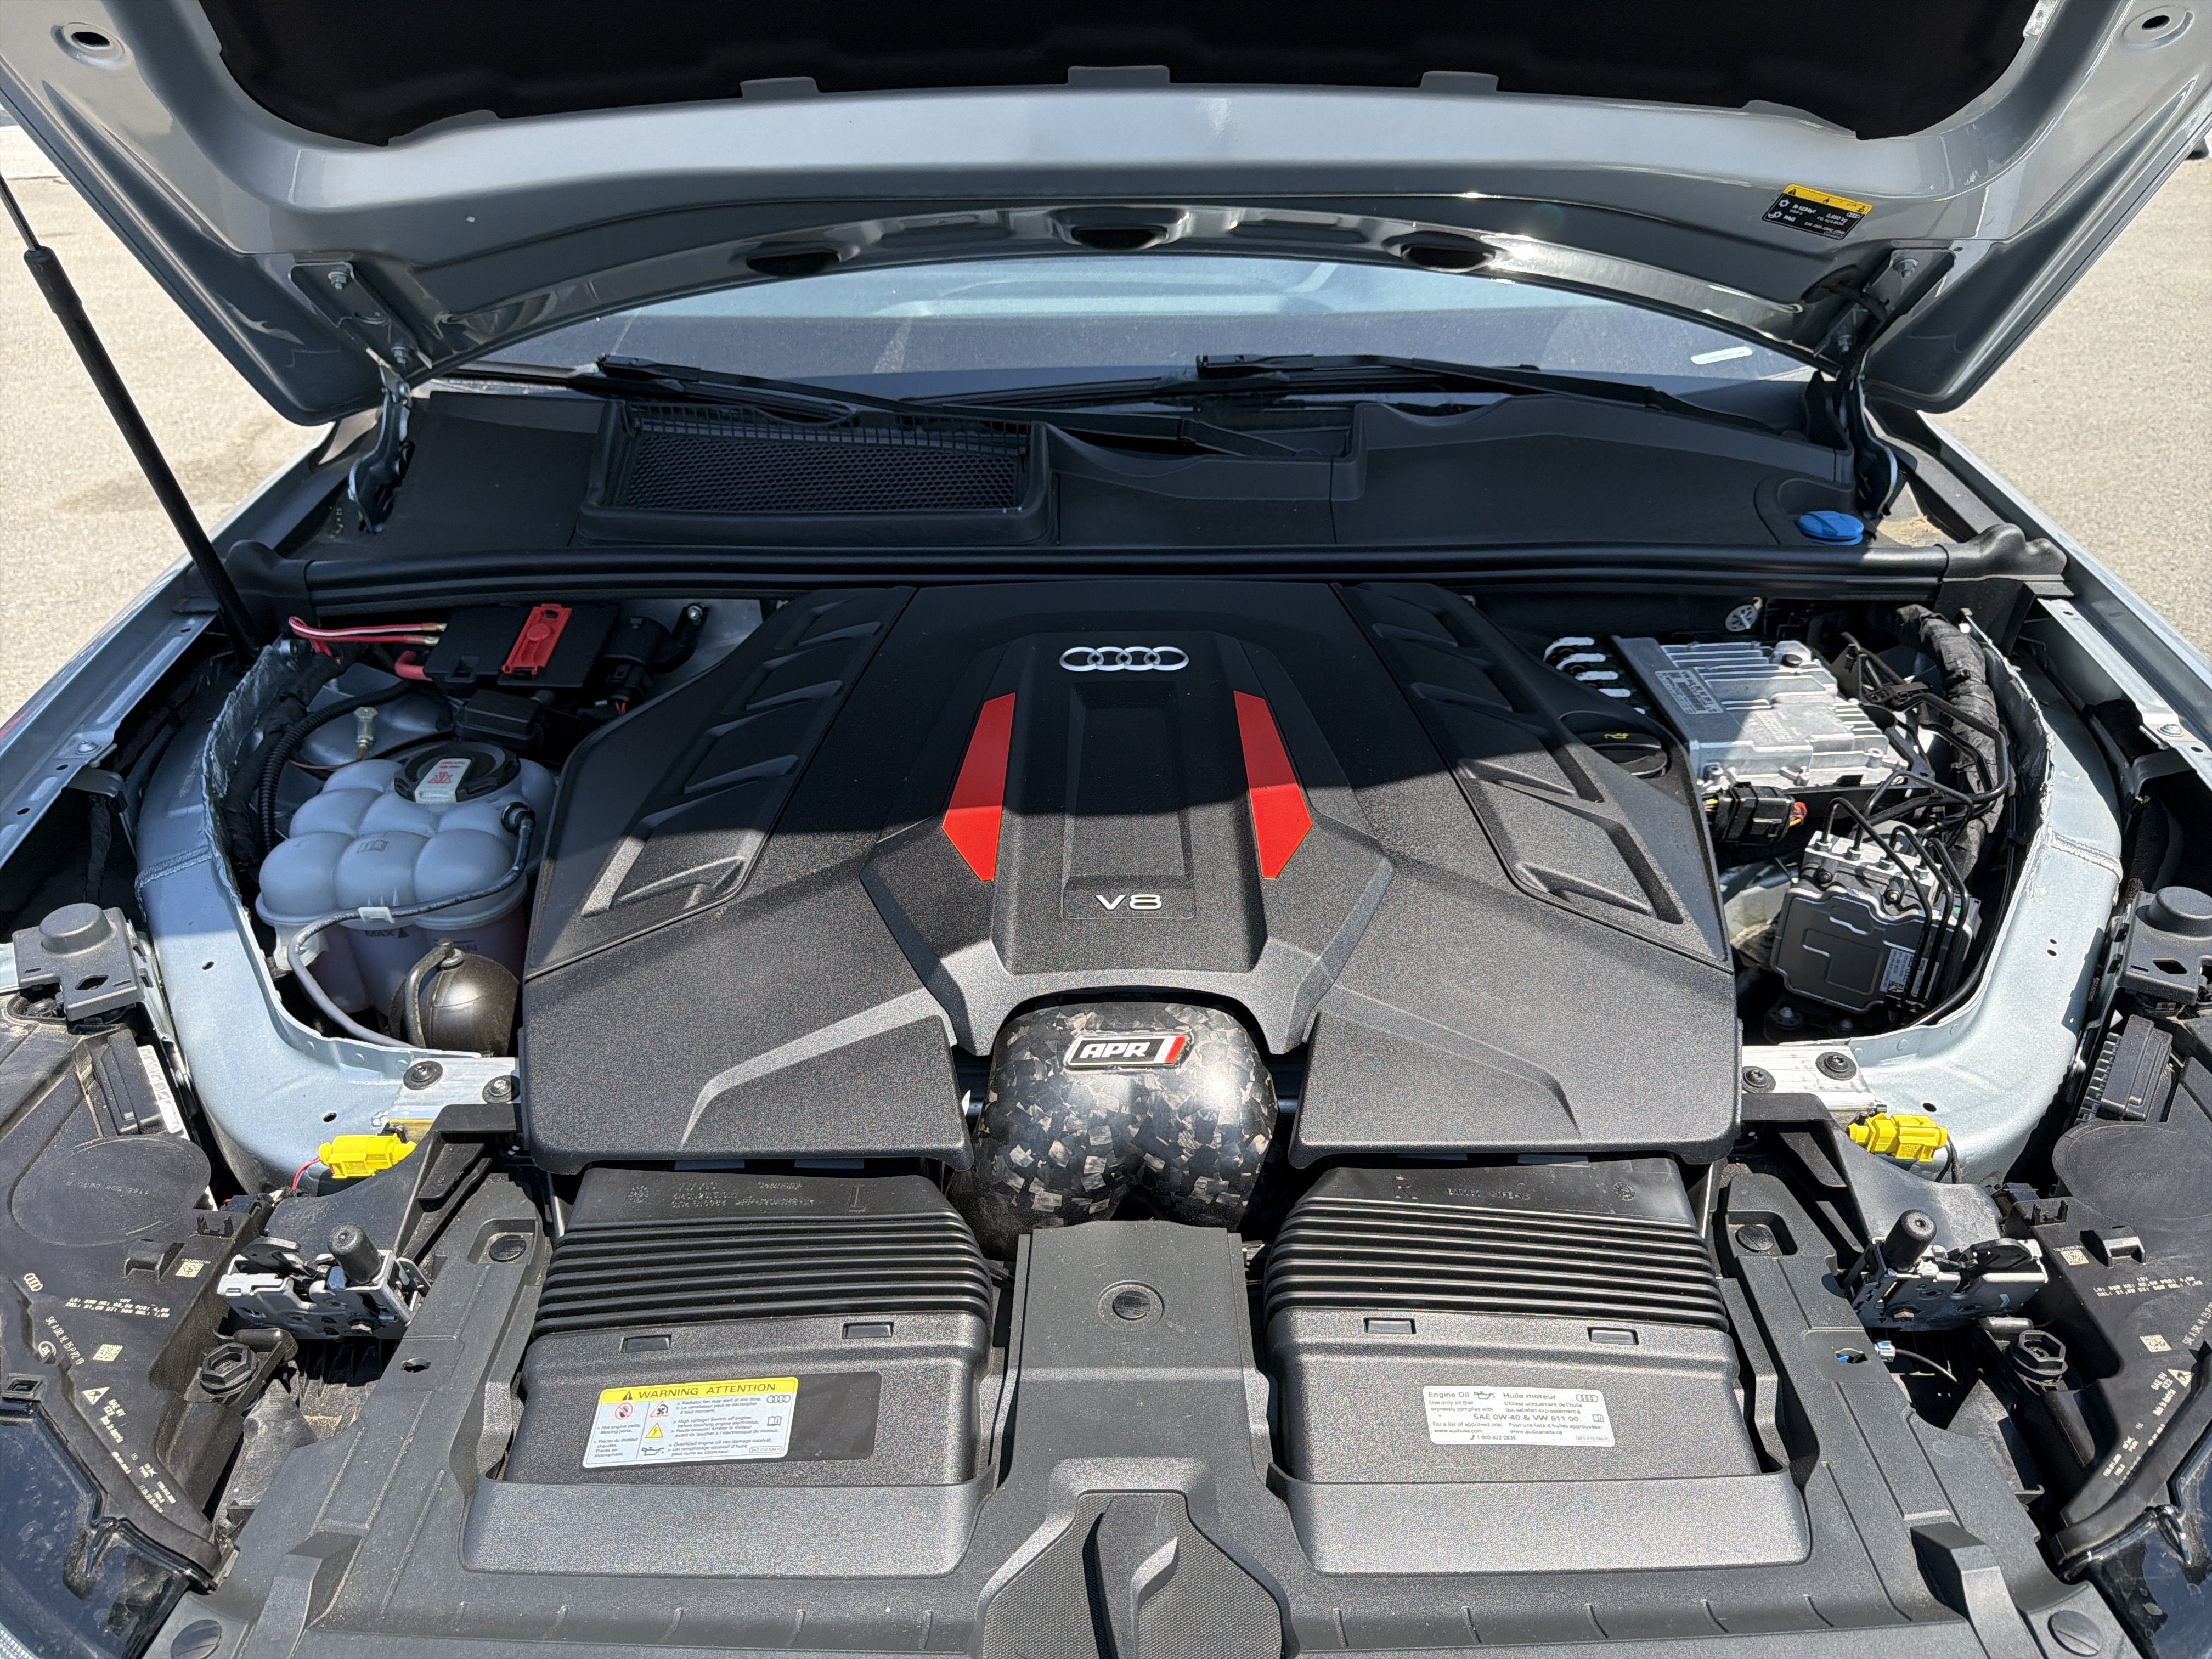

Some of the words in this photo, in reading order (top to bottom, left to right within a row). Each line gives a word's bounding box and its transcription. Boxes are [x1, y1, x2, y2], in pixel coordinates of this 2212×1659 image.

[1096, 894, 1163, 910] V8
[1079, 1042, 1150, 1058] APR
[638, 1387, 699, 1400] WARNING
[705, 1383, 776, 1395] ATTENTION
